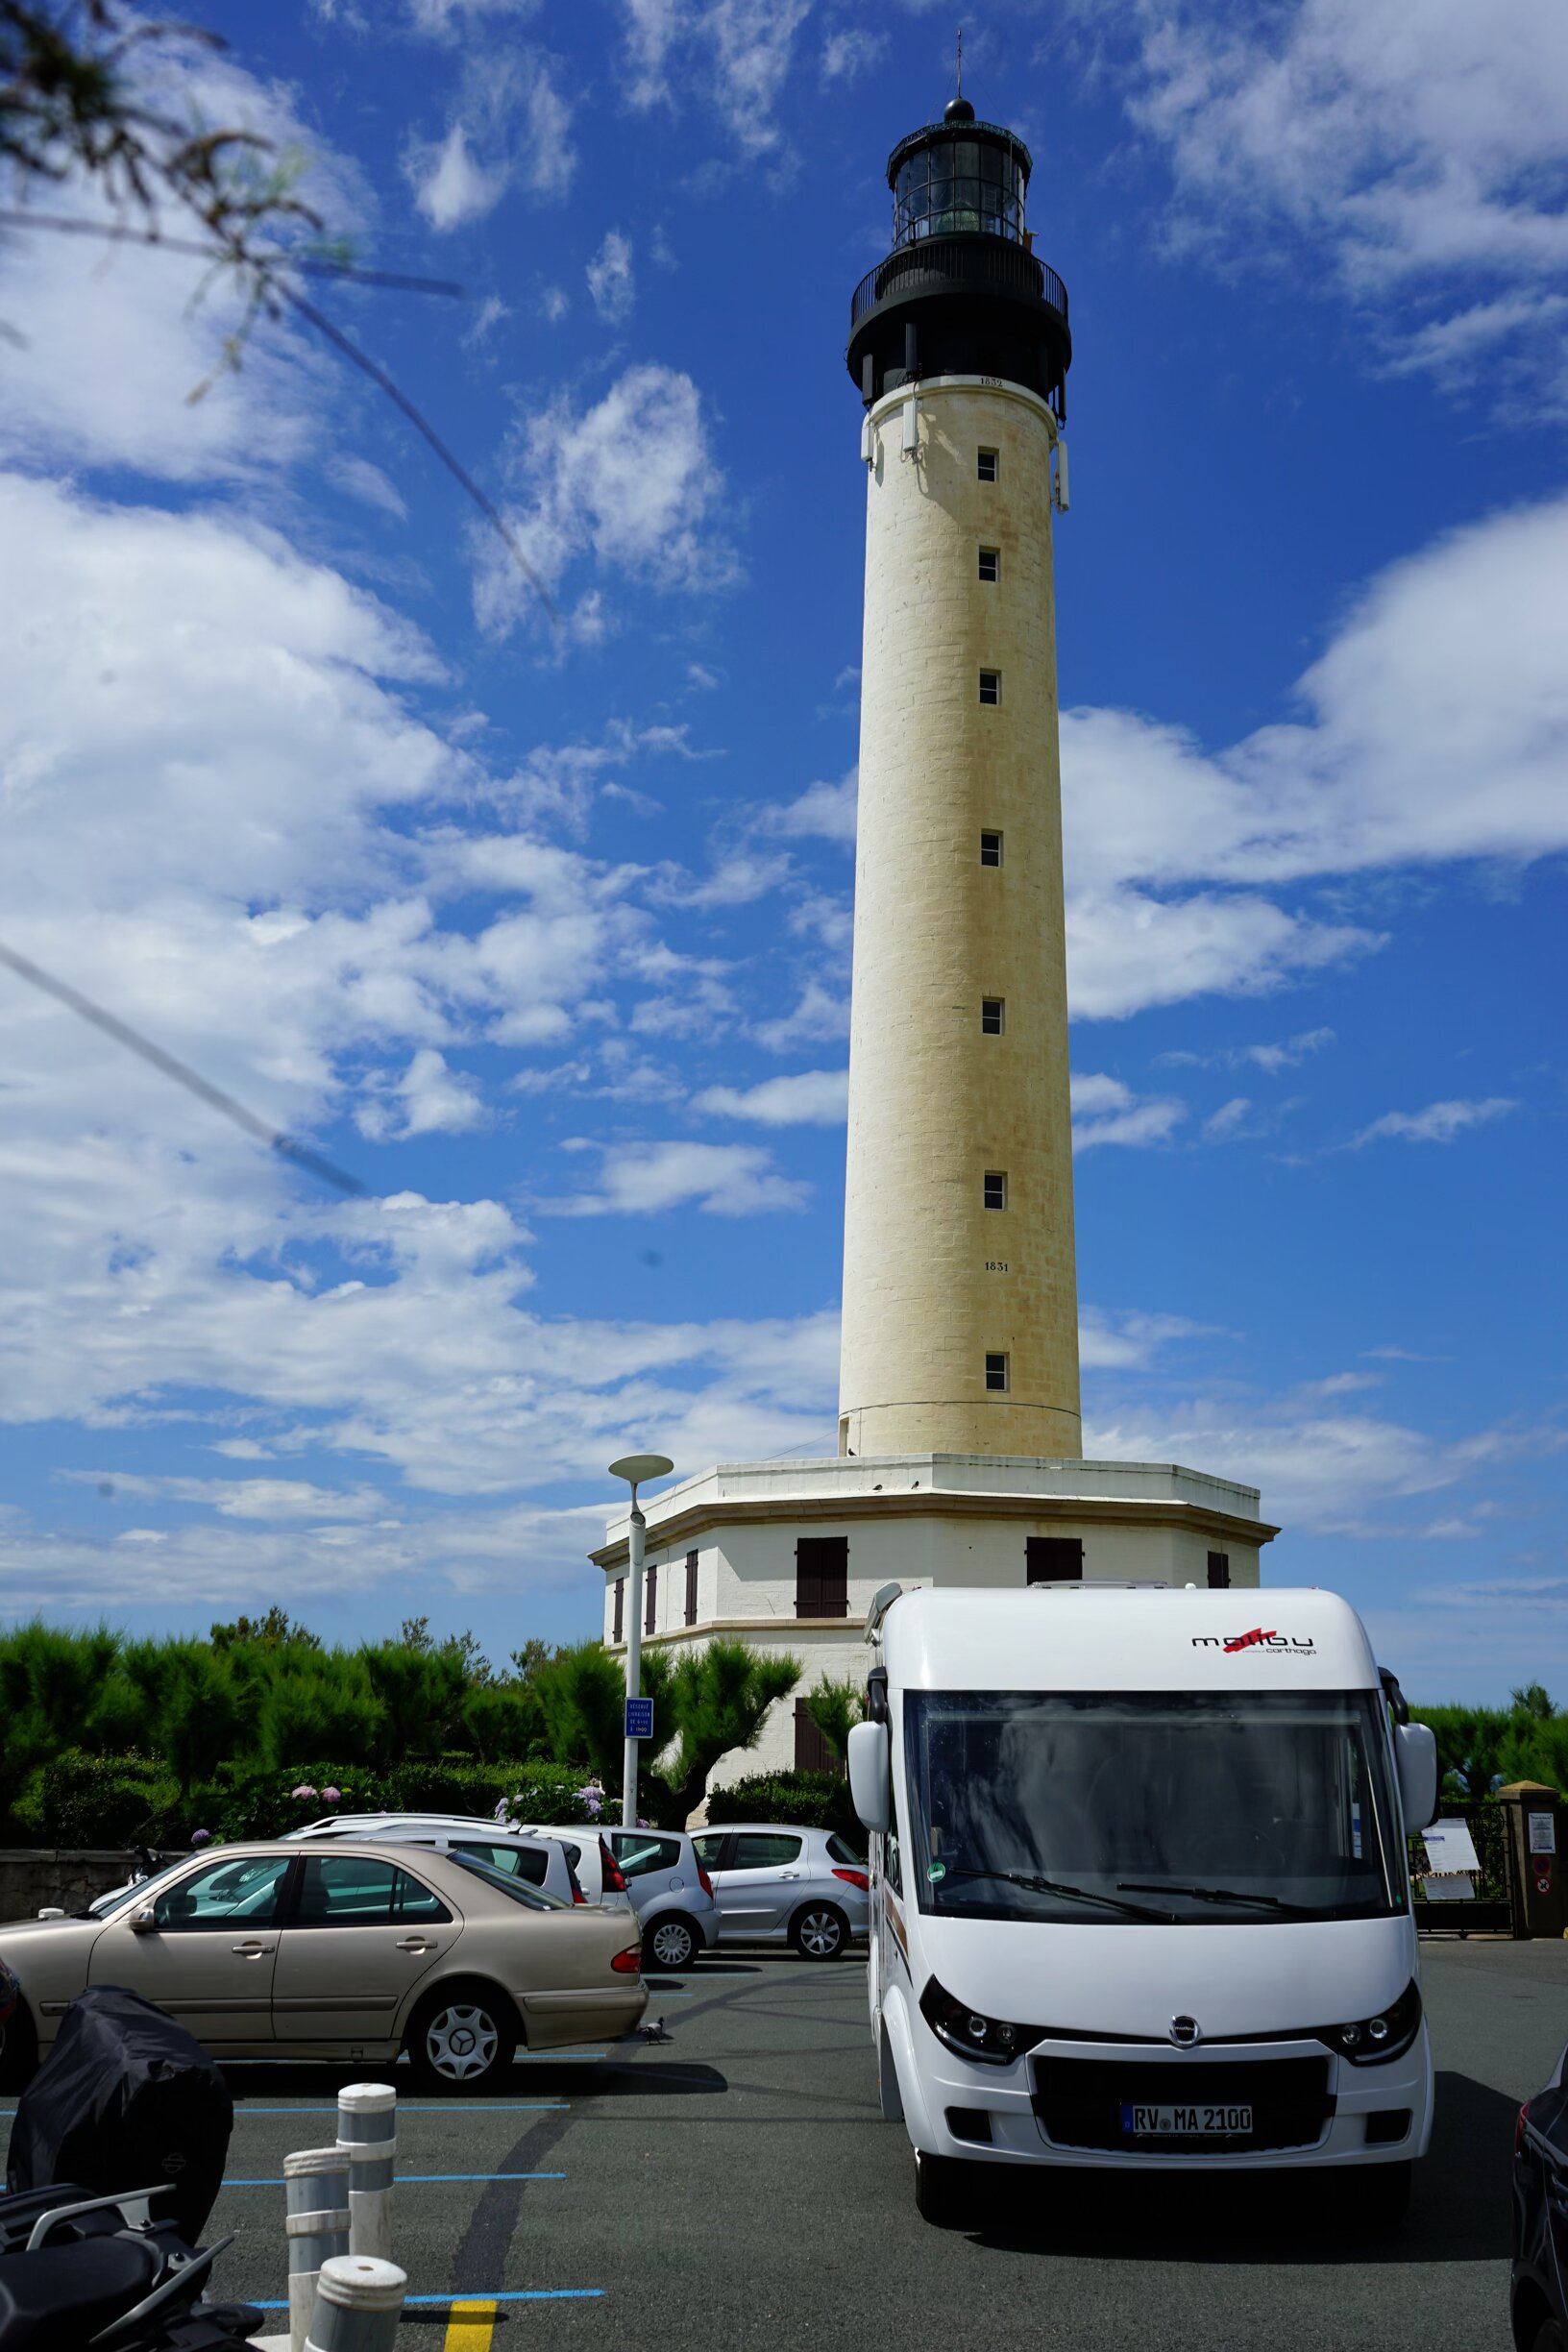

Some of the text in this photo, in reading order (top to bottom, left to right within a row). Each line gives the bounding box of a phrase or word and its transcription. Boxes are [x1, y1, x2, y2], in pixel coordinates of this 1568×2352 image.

[980, 377, 1003, 388] 1832
[984, 1261, 1009, 1272] 1831
[1191, 1632, 1314, 1647] malibu
[1265, 1647, 1317, 1655] carthago
[1134, 2108, 1159, 2130] RV
[1173, 2108, 1199, 2130] MA
[1203, 2108, 1251, 2130] 2100
